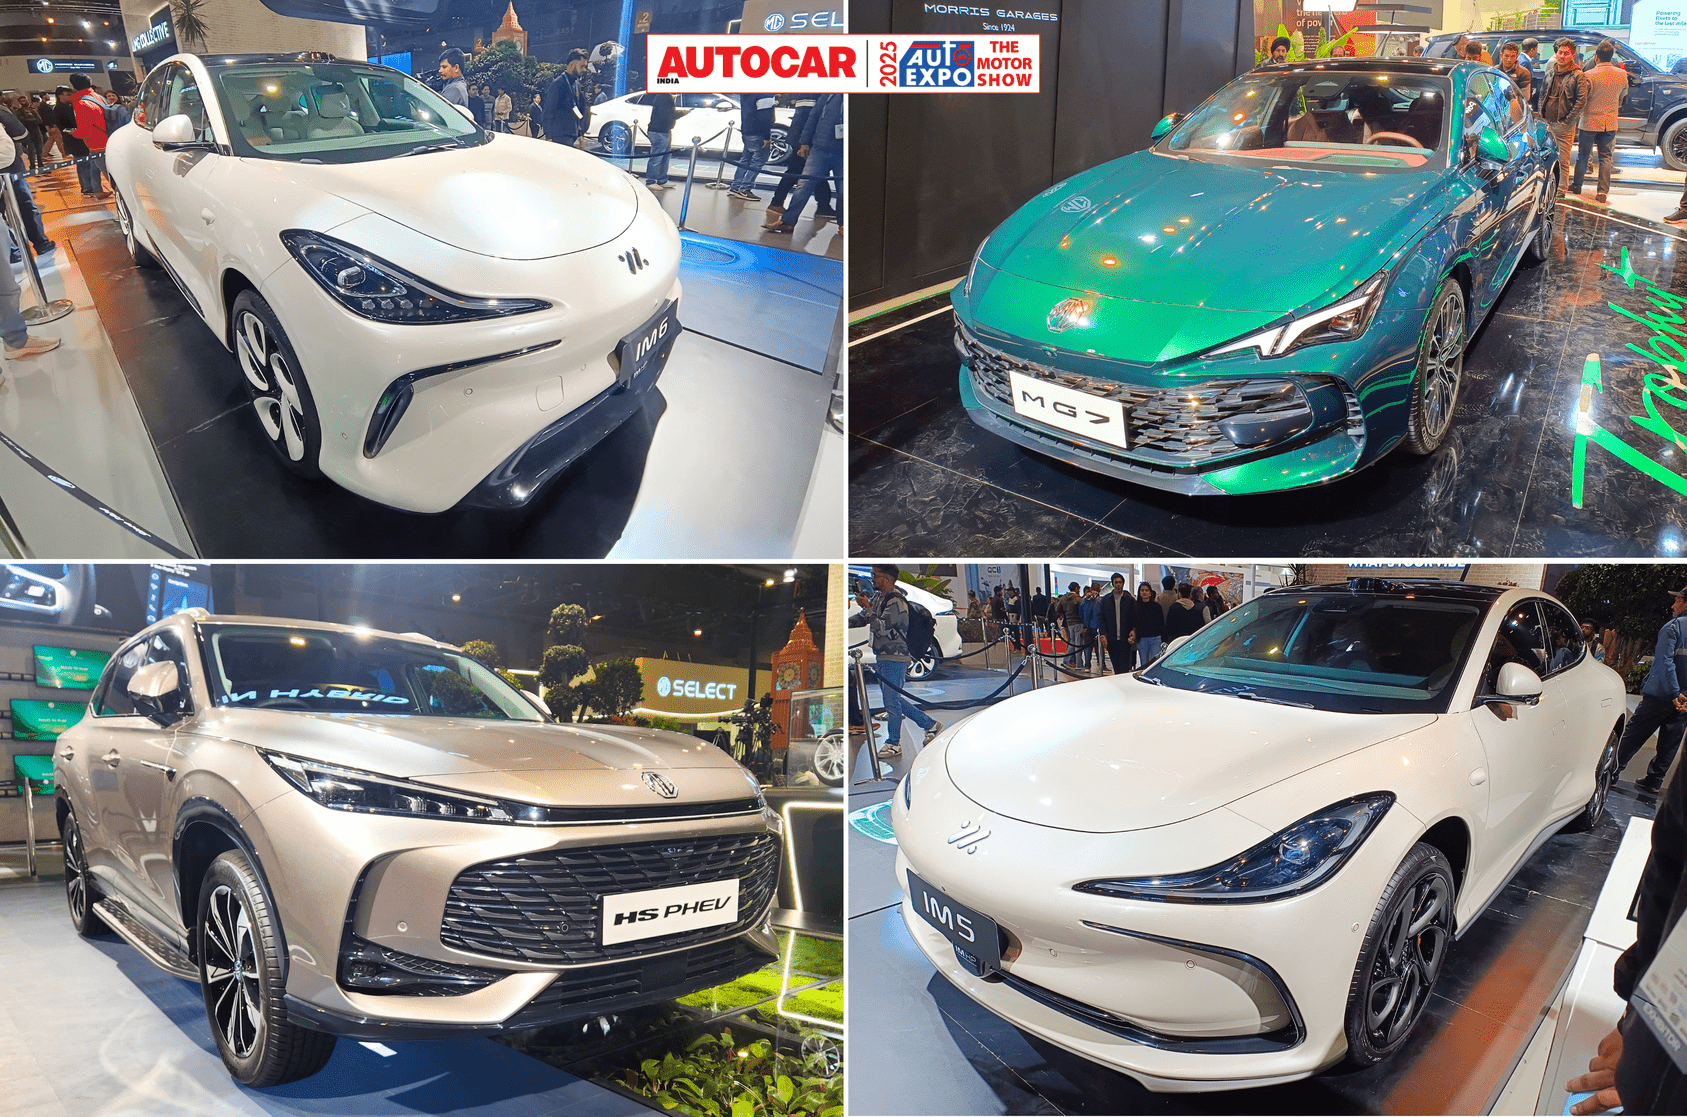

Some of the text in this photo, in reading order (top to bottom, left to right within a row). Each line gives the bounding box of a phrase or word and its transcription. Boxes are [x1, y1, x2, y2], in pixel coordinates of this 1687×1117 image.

[790, 11, 844, 29] SEL
[924, 3, 1058, 22] MORRIS GARAGES
[982, 22, 1016, 32] Since 1924
[1296, 18, 1306, 27] of
[635, 317, 669, 362] IM6
[672, 679, 737, 700] SELECT
[613, 896, 732, 926] HS PHEV
